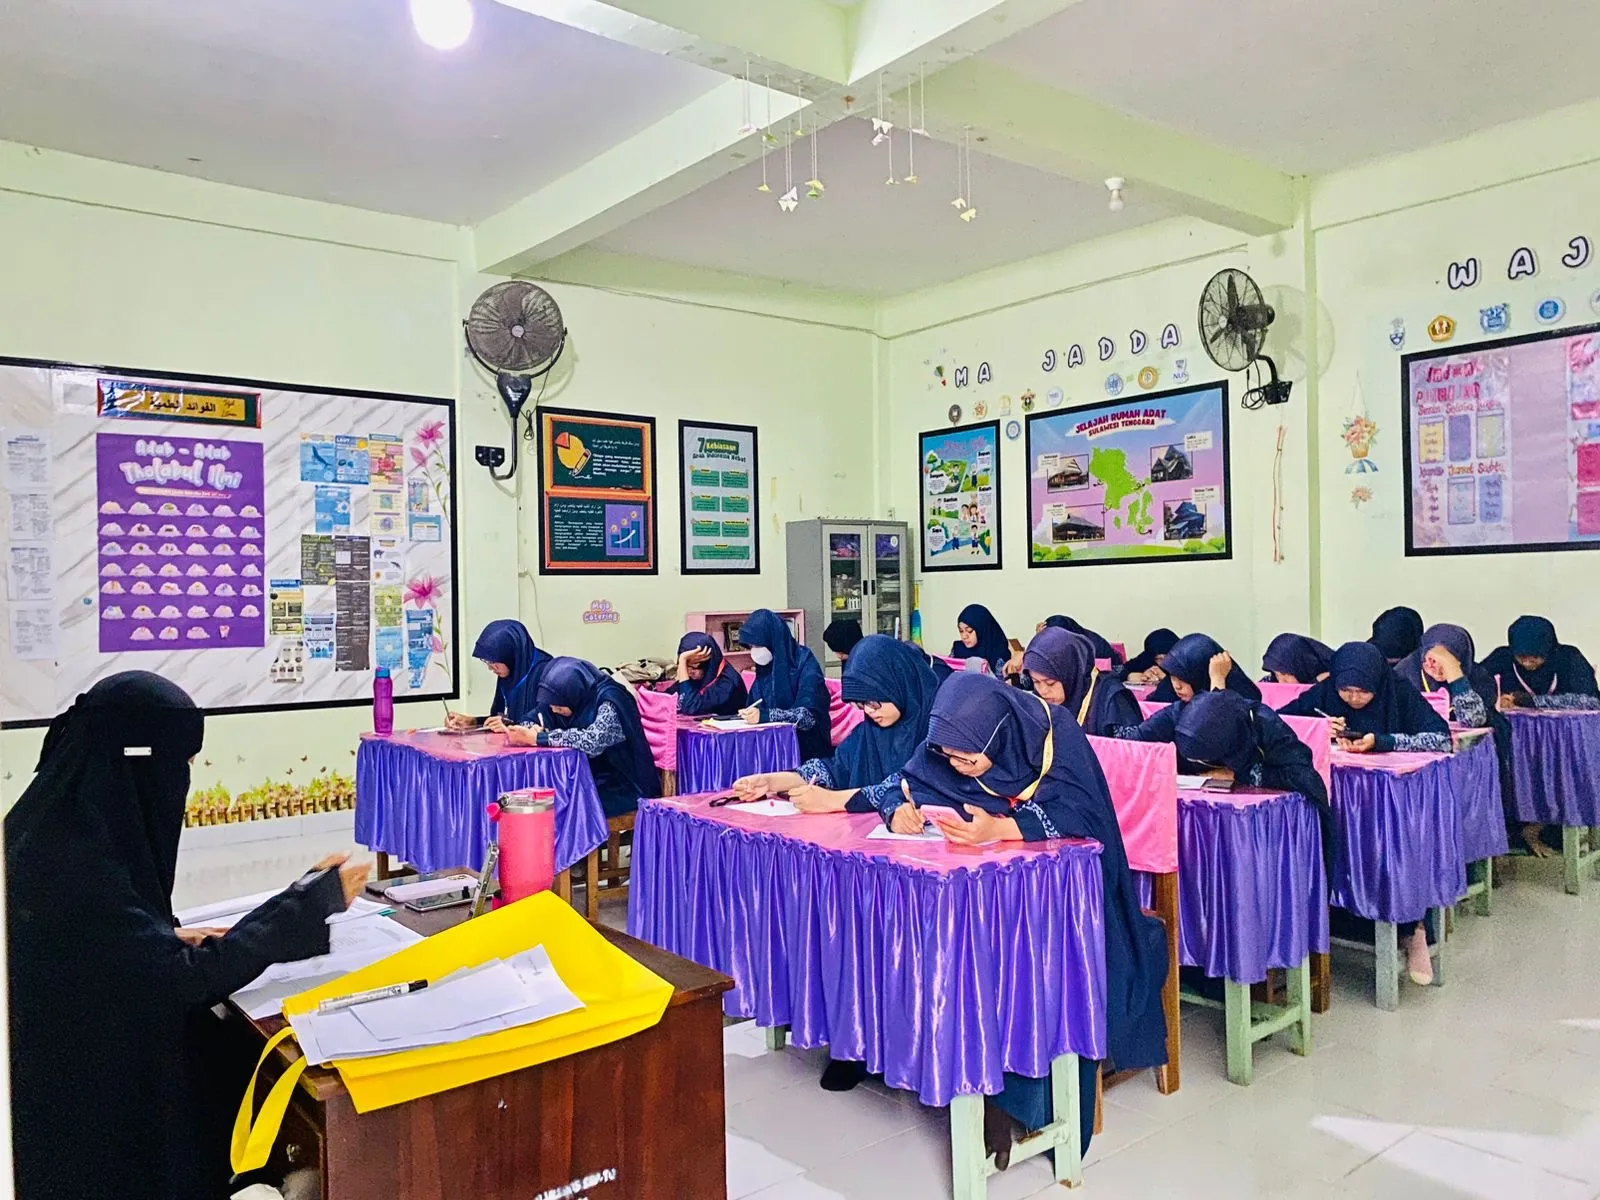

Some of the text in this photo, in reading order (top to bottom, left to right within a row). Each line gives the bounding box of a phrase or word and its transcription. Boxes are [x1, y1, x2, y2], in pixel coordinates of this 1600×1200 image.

[1042, 323, 1179, 372] JADDA
[1076, 409, 1167, 434] JELAJAH RUMAH ADAT
[1088, 421, 1120, 437] SULAWESI
[135, 439, 175, 457] Adab
[193, 442, 231, 461] Adab
[697, 437, 738, 453] 7 Kebiasaan
[119, 457, 243, 490] Thalabul Ilmi
